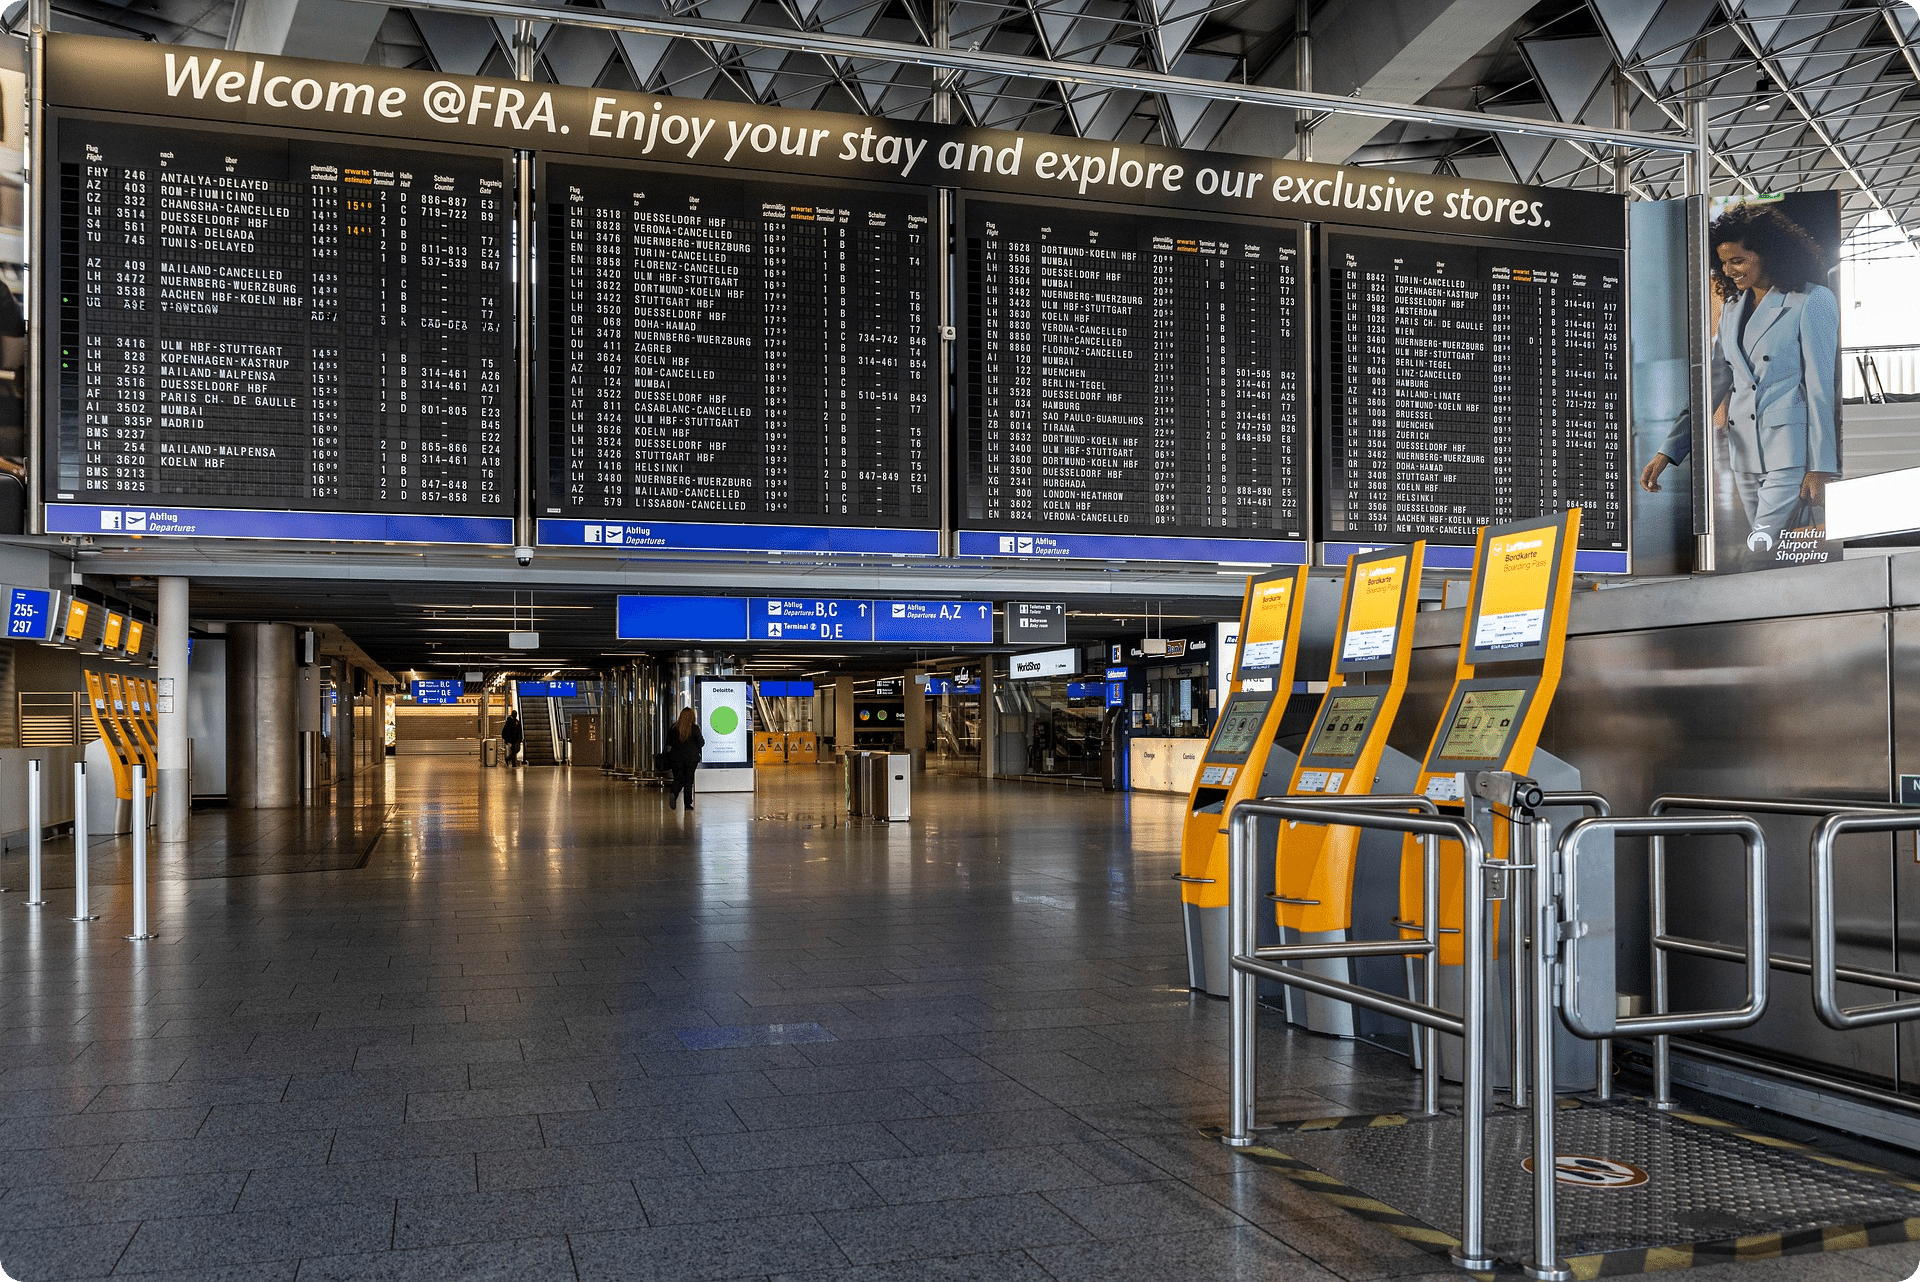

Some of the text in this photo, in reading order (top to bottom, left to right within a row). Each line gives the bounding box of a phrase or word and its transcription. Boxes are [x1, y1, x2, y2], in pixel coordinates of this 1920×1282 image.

[164, 53, 1552, 229] Welcome @FRA. Enjoy your stay and explore our exclusive stores.
[86, 144, 99, 153] Flug
[86, 153, 103, 161] Flight
[160, 151, 174, 159] nach
[225, 156, 238, 164] über
[311, 165, 338, 174] planmäßig
[344, 168, 369, 176] erwartet
[372, 169, 394, 178] Terminal
[311, 173, 338, 182] scheduled
[344, 177, 372, 185] estimated
[399, 172, 413, 180] Halle
[434, 175, 455, 183] Schalter
[373, 178, 395, 186] Terminal
[400, 180, 411, 188] Hall
[434, 183, 455, 191] Counter
[479, 178, 502, 188] Flugsteig
[87, 166, 494, 210] FHY 246 ANTALYA-DELAYED 886-887 E3
[479, 187, 492, 195] Gate
[570, 218, 733, 240] EN 8828 VERONA-CANCELLED
[86, 231, 500, 271] TU 745 TUNIS-DELAYED 537-539 B47
[986, 240, 1290, 274] LH 3628 DORTMUND-KOELN HBF T6
[1346, 281, 1617, 312] LH 824 KOPENHAGEN-KASTRUP 314-461 A17
[570, 314, 927, 346] QR 068 DOHA-HAMAD 734-742 B46
[987, 341, 998, 351] EN
[1009, 342, 1031, 353] 8860
[87, 348, 500, 381] LH 828 KOPENHAGEN-KASTRUP 314-461 A26
[1347, 365, 1462, 382] EN 8040 LINZ-CANCELLED
[1347, 386, 1614, 411] AZ 413 MAILAND-LINATE 721-722 B9
[570, 399, 752, 417] AT 811 CASABLANC-CANCELLED
[987, 408, 1296, 434] LA 8071 SAO PAULO-GUARULHOS 747-750 B26
[571, 459, 927, 482] AY 1416 HELSINKI 847-849 E21
[86, 479, 501, 504] BMS 9825 857-858 E26
[988, 487, 1297, 508] LH 900 LONDON-HEATHROW 314-461 Z22
[149, 512, 178, 522] Abflug
[149, 523, 196, 532] Departures
[626, 526, 650, 536] Abflug
[626, 536, 666, 546] Departures
[1035, 537, 1057, 546] Abflug
[1778, 540, 1819, 552] Airport
[1035, 547, 1070, 555] Departures
[1505, 551, 1538, 562] Bordkarte
[1775, 550, 1829, 563] Shopping
[1532, 559, 1547, 568] Pass
[1367, 576, 1392, 586] Bordkarte
[784, 601, 802, 609] Abflug
[815, 602, 838, 618] B,C
[907, 603, 925, 612] Abflug
[784, 609, 814, 617] Departures
[907, 611, 936, 619] Departures
[939, 604, 962, 621] A,Z
[12, 620, 32, 633] 297
[784, 622, 808, 630] Terminal
[820, 623, 843, 640] D,E
[1016, 661, 1041, 672] WorldShop
[1175, 666, 1193, 677] Change
